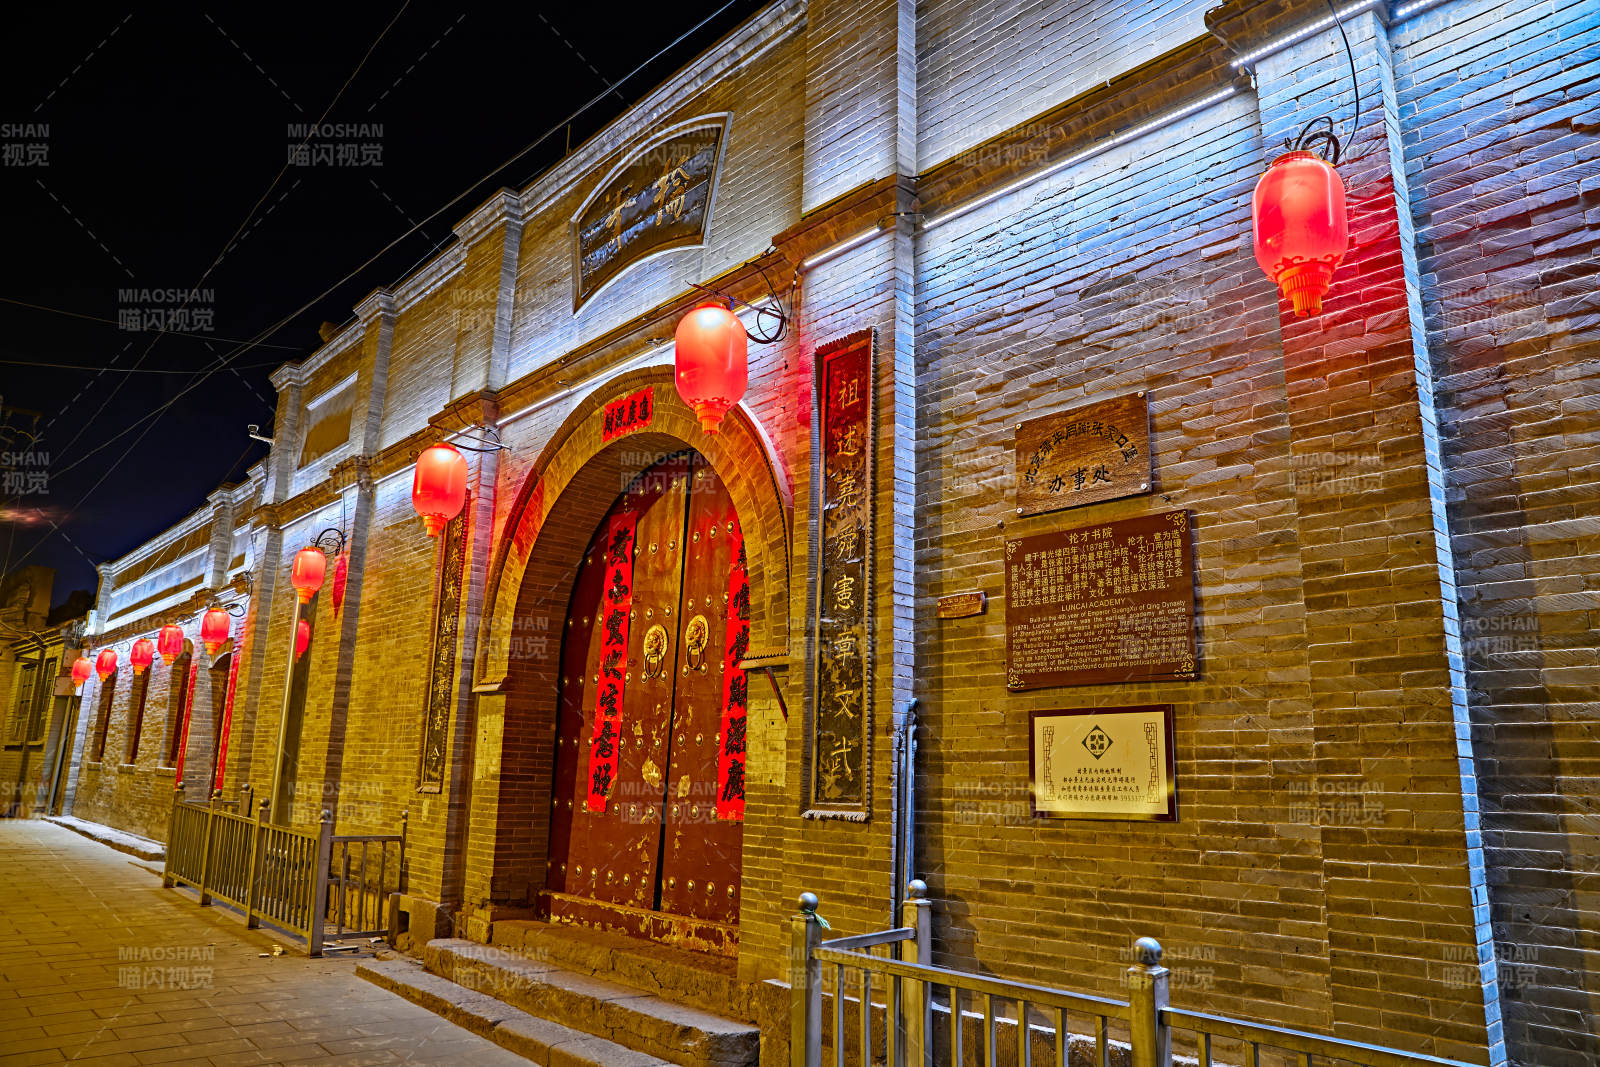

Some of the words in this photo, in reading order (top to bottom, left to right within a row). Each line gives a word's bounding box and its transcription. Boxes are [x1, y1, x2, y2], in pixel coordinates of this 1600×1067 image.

[1048, 464, 1111, 494] 办事处
[1069, 527, 1113, 544] 抡才书院
[830, 377, 861, 783] 祖述堯舜憲章文武
[1062, 602, 1088, 612] LUNCAI
[1090, 598, 1125, 608] ACADEMY
